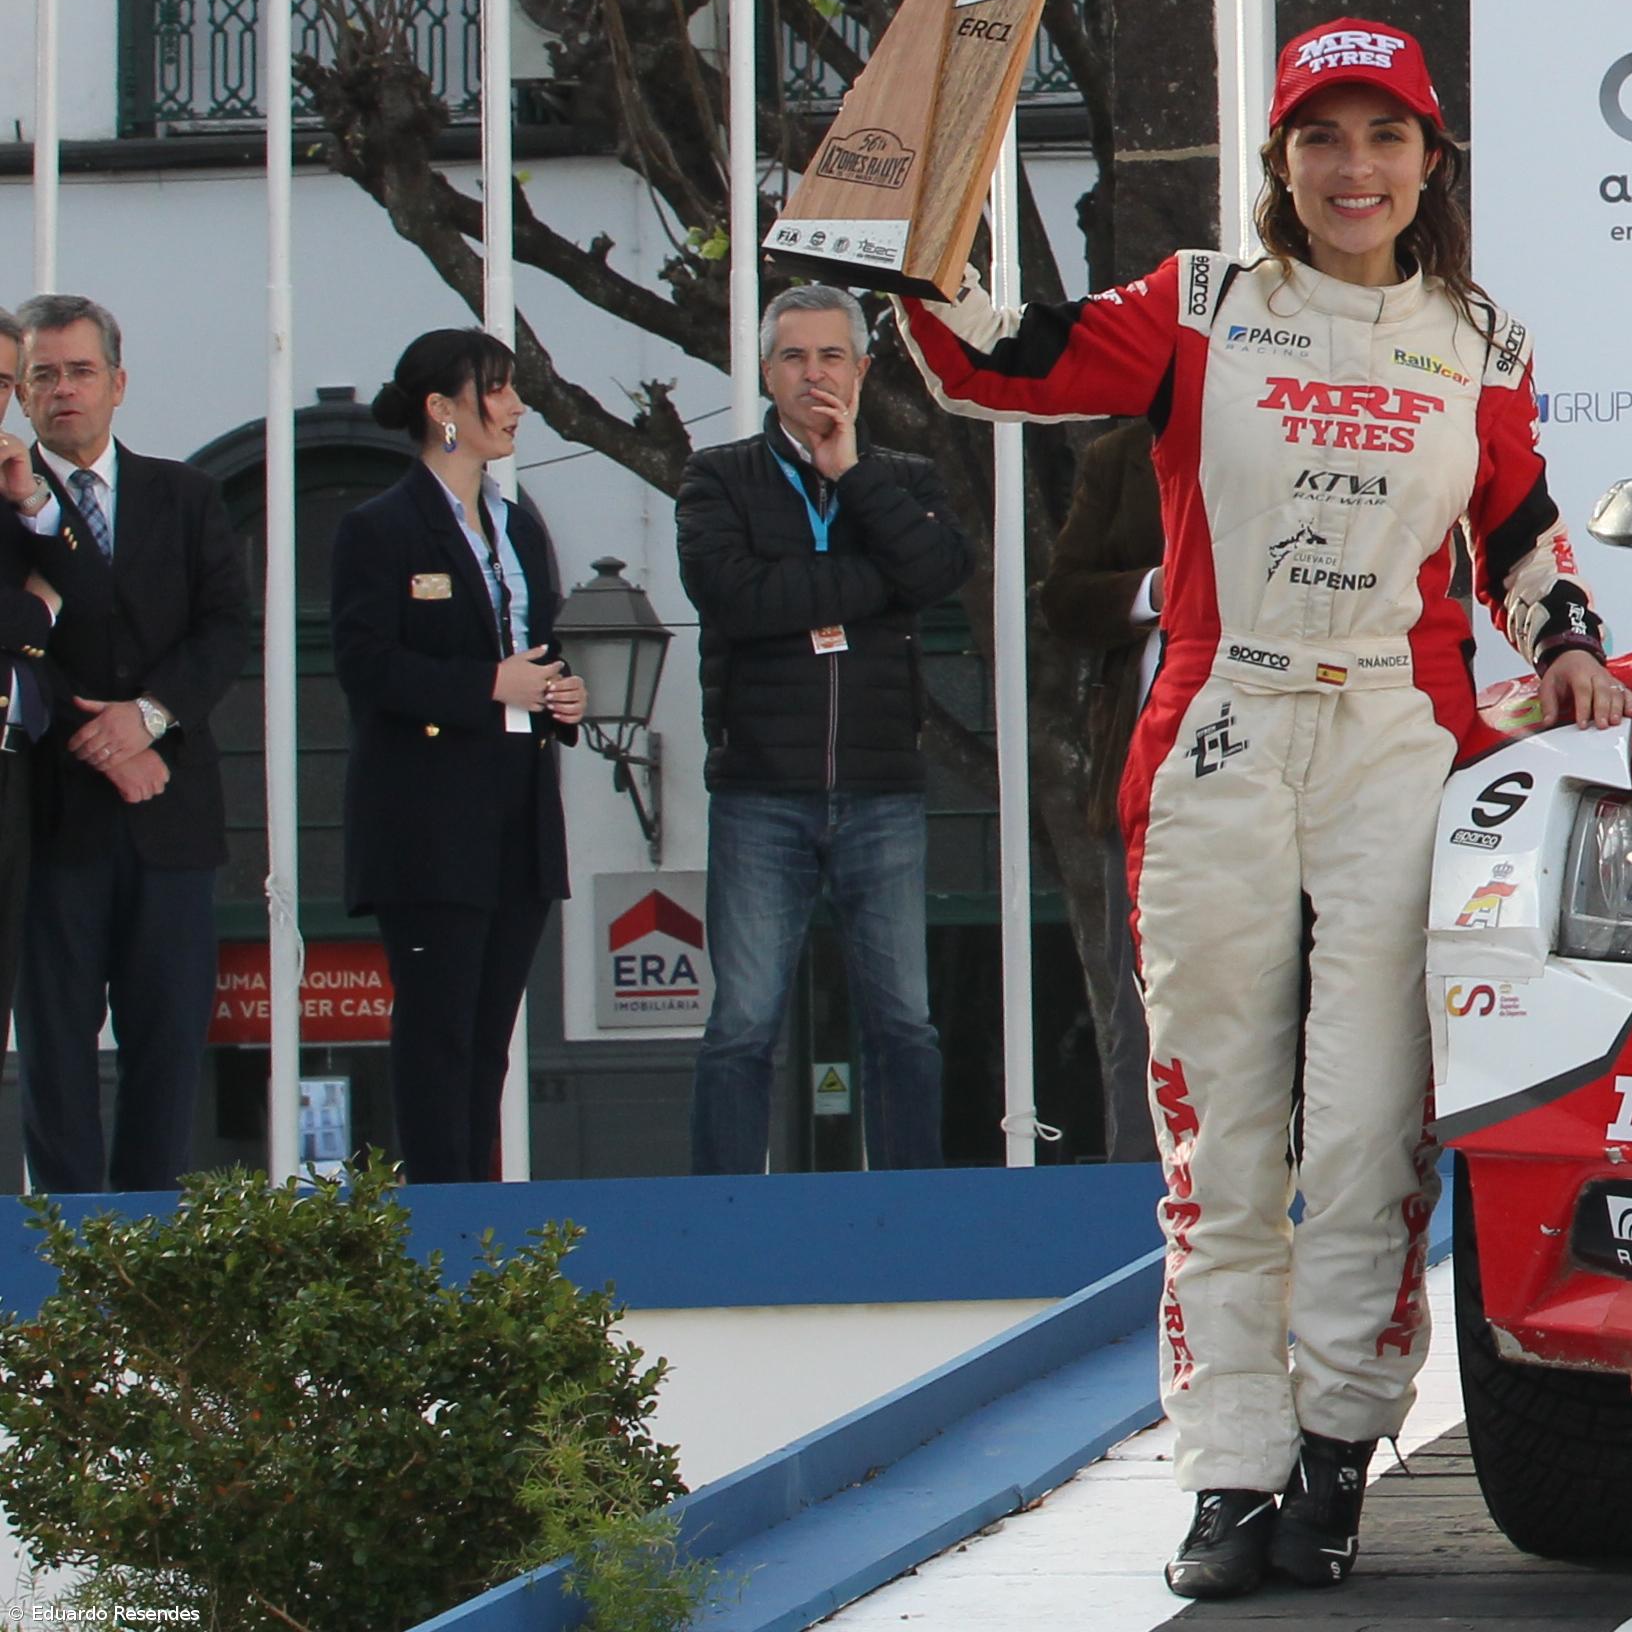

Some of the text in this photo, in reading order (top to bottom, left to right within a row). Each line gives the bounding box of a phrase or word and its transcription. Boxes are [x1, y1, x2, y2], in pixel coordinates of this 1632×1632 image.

[958, 17, 1013, 43] ERC1
[1294, 30, 1405, 68] MRF
[1308, 51, 1393, 74] TYRES
[1224, 343, 1310, 358] RACING
[1248, 327, 1312, 349] PAGID
[1393, 348, 1470, 386] Rallycar
[1257, 377, 1445, 424] MRF
[1281, 417, 1416, 454] TYRES
[1293, 469, 1388, 496] KTVA
[1290, 567, 1377, 590] ELPENDO
[1227, 645, 1291, 670] sparco
[216, 973, 267, 990] UMA
[614, 954, 698, 986] ERA
[614, 999, 699, 1011] IMOBILIÁRIA
